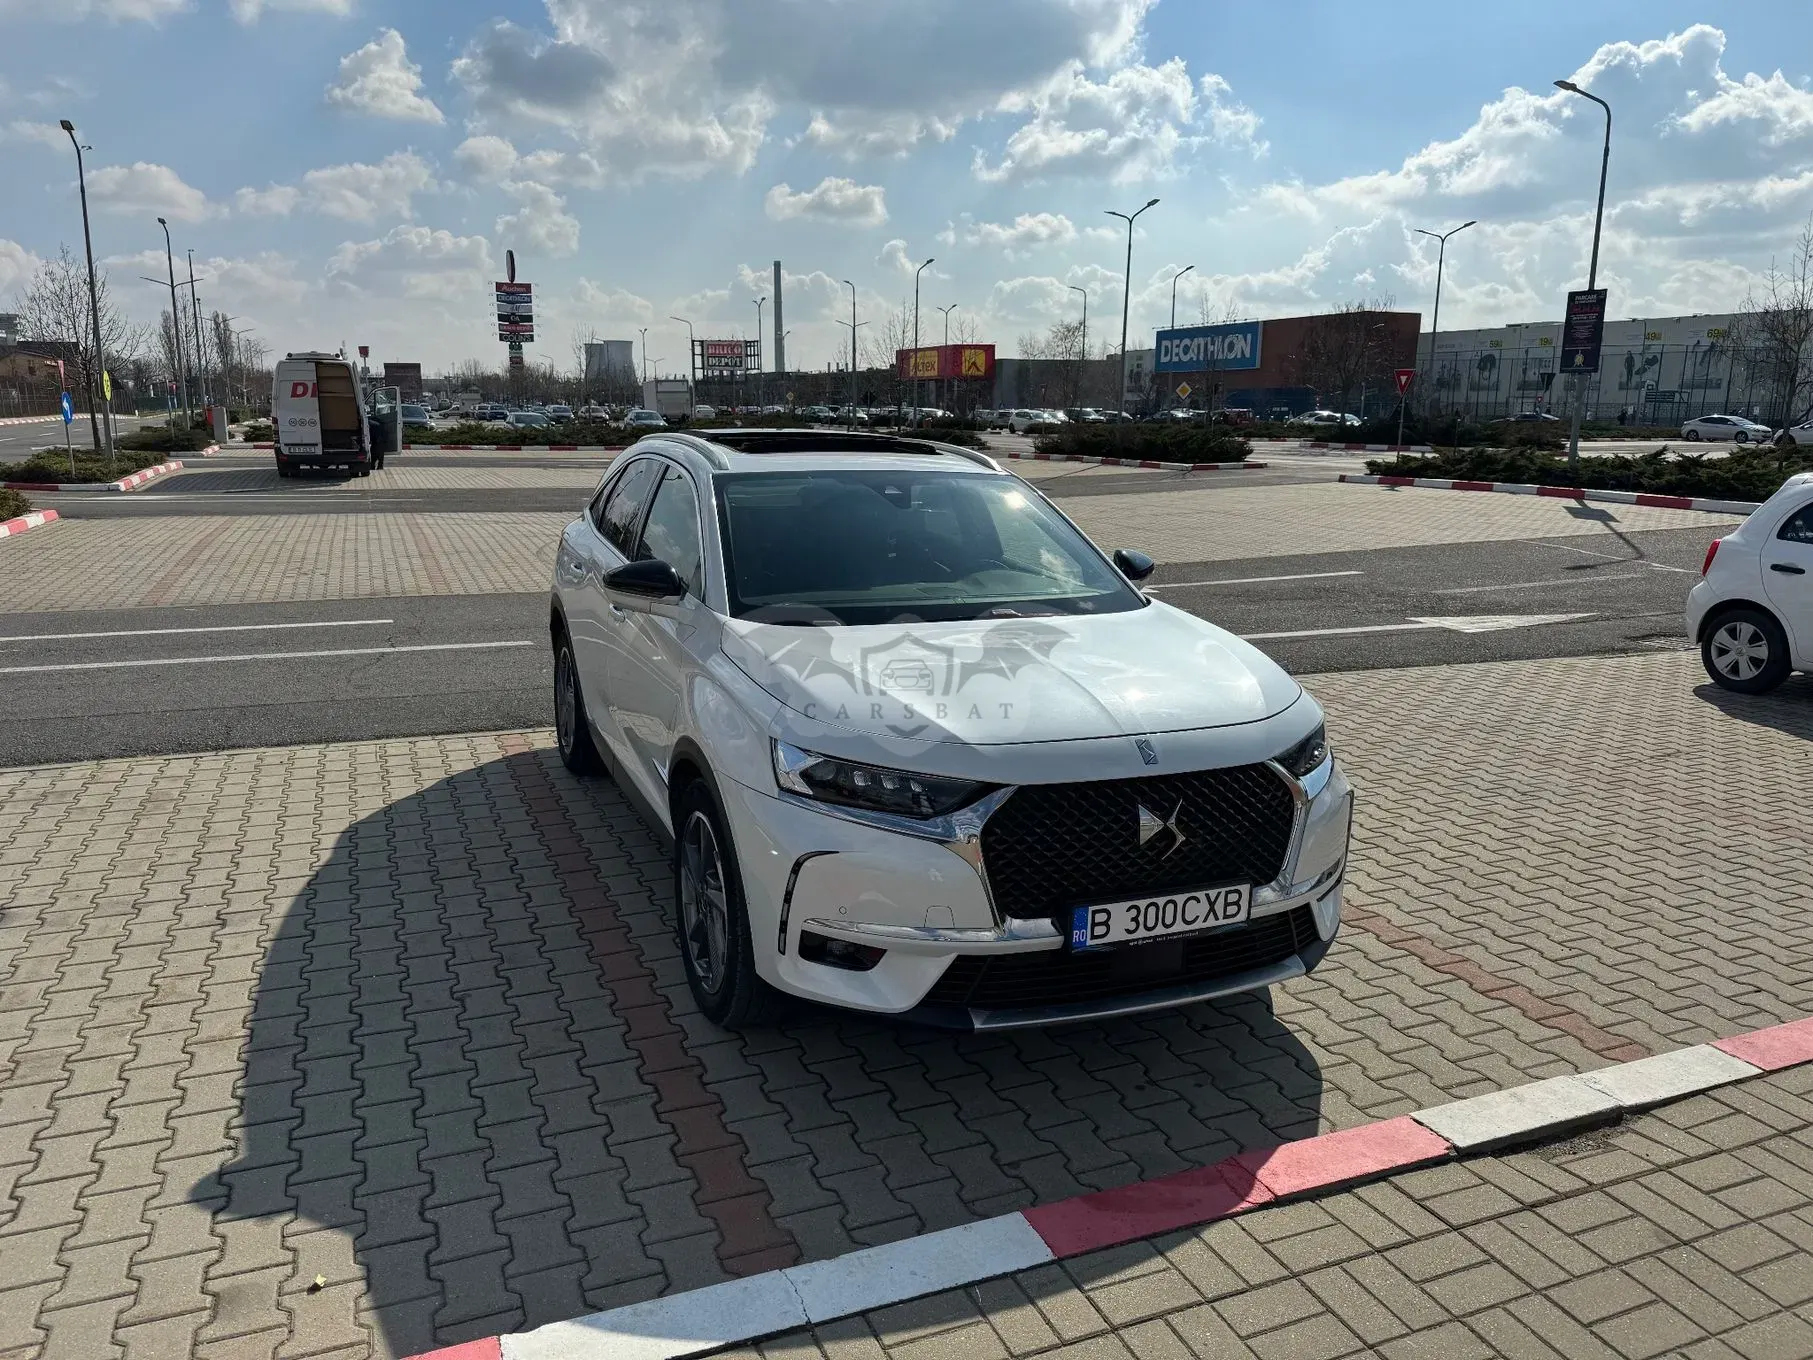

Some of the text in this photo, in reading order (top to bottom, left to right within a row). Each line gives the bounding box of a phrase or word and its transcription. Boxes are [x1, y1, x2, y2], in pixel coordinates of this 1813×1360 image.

[708, 345, 742, 354] BRICO
[1159, 333, 1253, 363] DECATHLON
[1090, 888, 1243, 941] B 300CXB
[1072, 929, 1087, 943] RO
